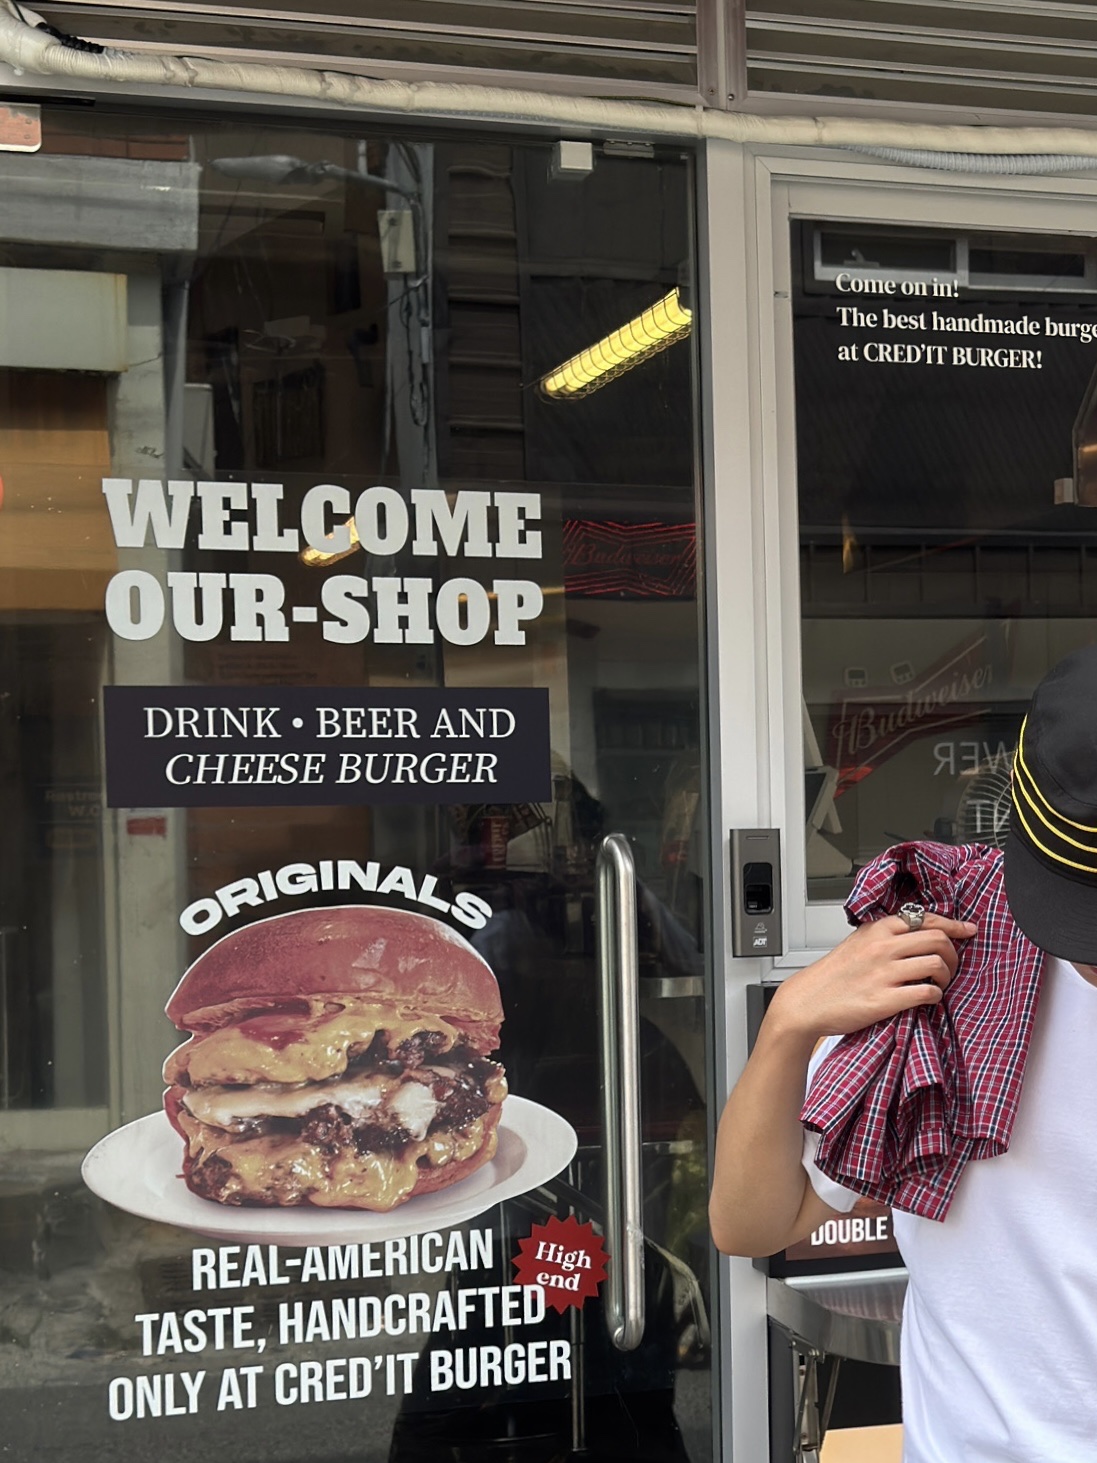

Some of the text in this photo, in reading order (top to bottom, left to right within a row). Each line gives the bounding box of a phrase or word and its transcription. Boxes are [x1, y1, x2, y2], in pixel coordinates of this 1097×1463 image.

[835, 273, 960, 299] Come on in!
[836, 306, 878, 328] The
[882, 308, 927, 330] best
[932, 310, 1041, 336] handmade
[837, 342, 1043, 369] at CRED'IT BURGER!
[101, 477, 543, 559] WELCOME
[105, 568, 544, 646] OUR-SHOP
[143, 707, 516, 739] DRINK BEER AND
[832, 662, 993, 756] Budweiser
[165, 752, 498, 785] CHEESE BURGER
[179, 859, 494, 937] ORIGINALS
[191, 1228, 494, 1291] REAL-AMERICAN
[535, 1241, 591, 1272] High
[536, 1272, 581, 1292] end
[134, 1283, 546, 1357] TASTE, HANDCRAFTED
[108, 1339, 572, 1421] ONLY AT CRED'IT BURGER
